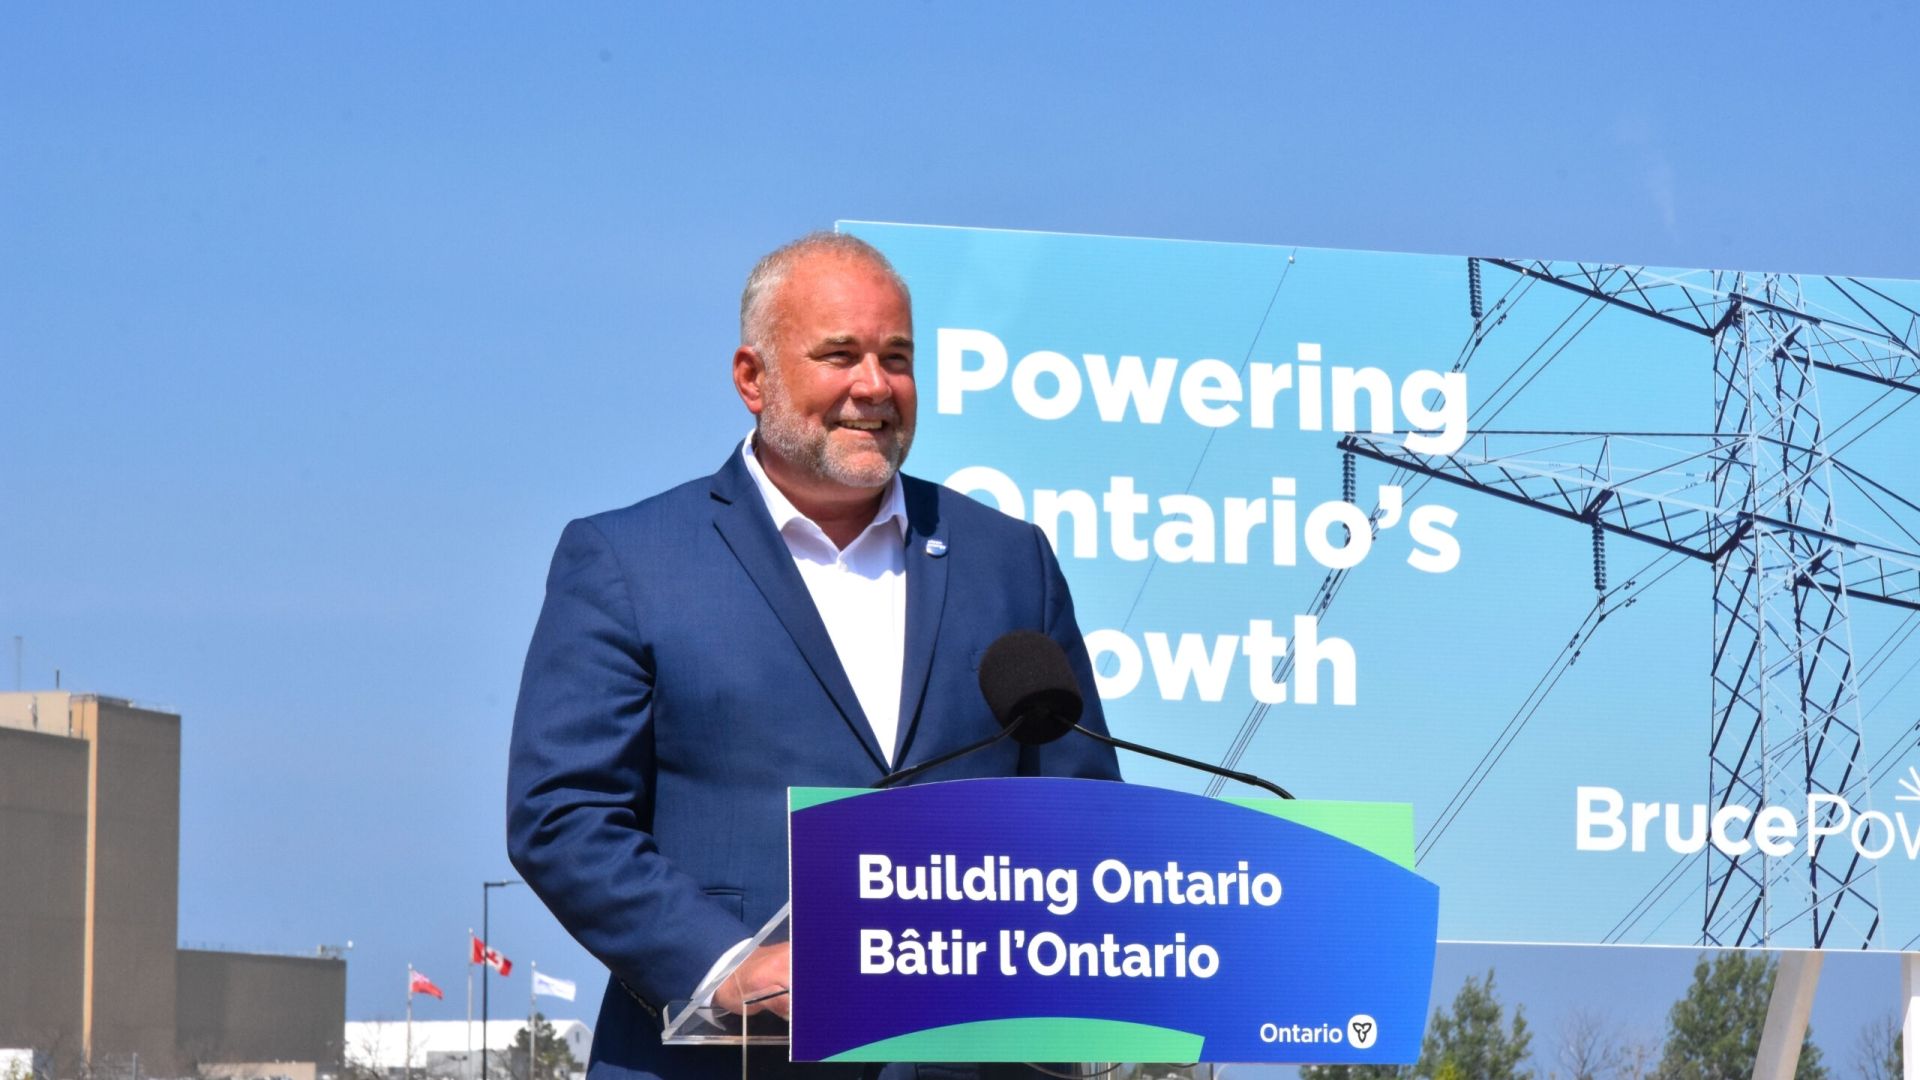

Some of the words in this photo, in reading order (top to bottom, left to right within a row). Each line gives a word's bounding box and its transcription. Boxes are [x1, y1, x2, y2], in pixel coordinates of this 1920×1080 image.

[937, 328, 1468, 455] Powering
[1082, 614, 1357, 706] owth
[859, 854, 1078, 915] Building
[1092, 859, 1282, 907] Ontario
[860, 928, 986, 975] Bâtir
[999, 929, 1220, 978] l'Ontario
[1260, 1023, 1343, 1044] Ontario
